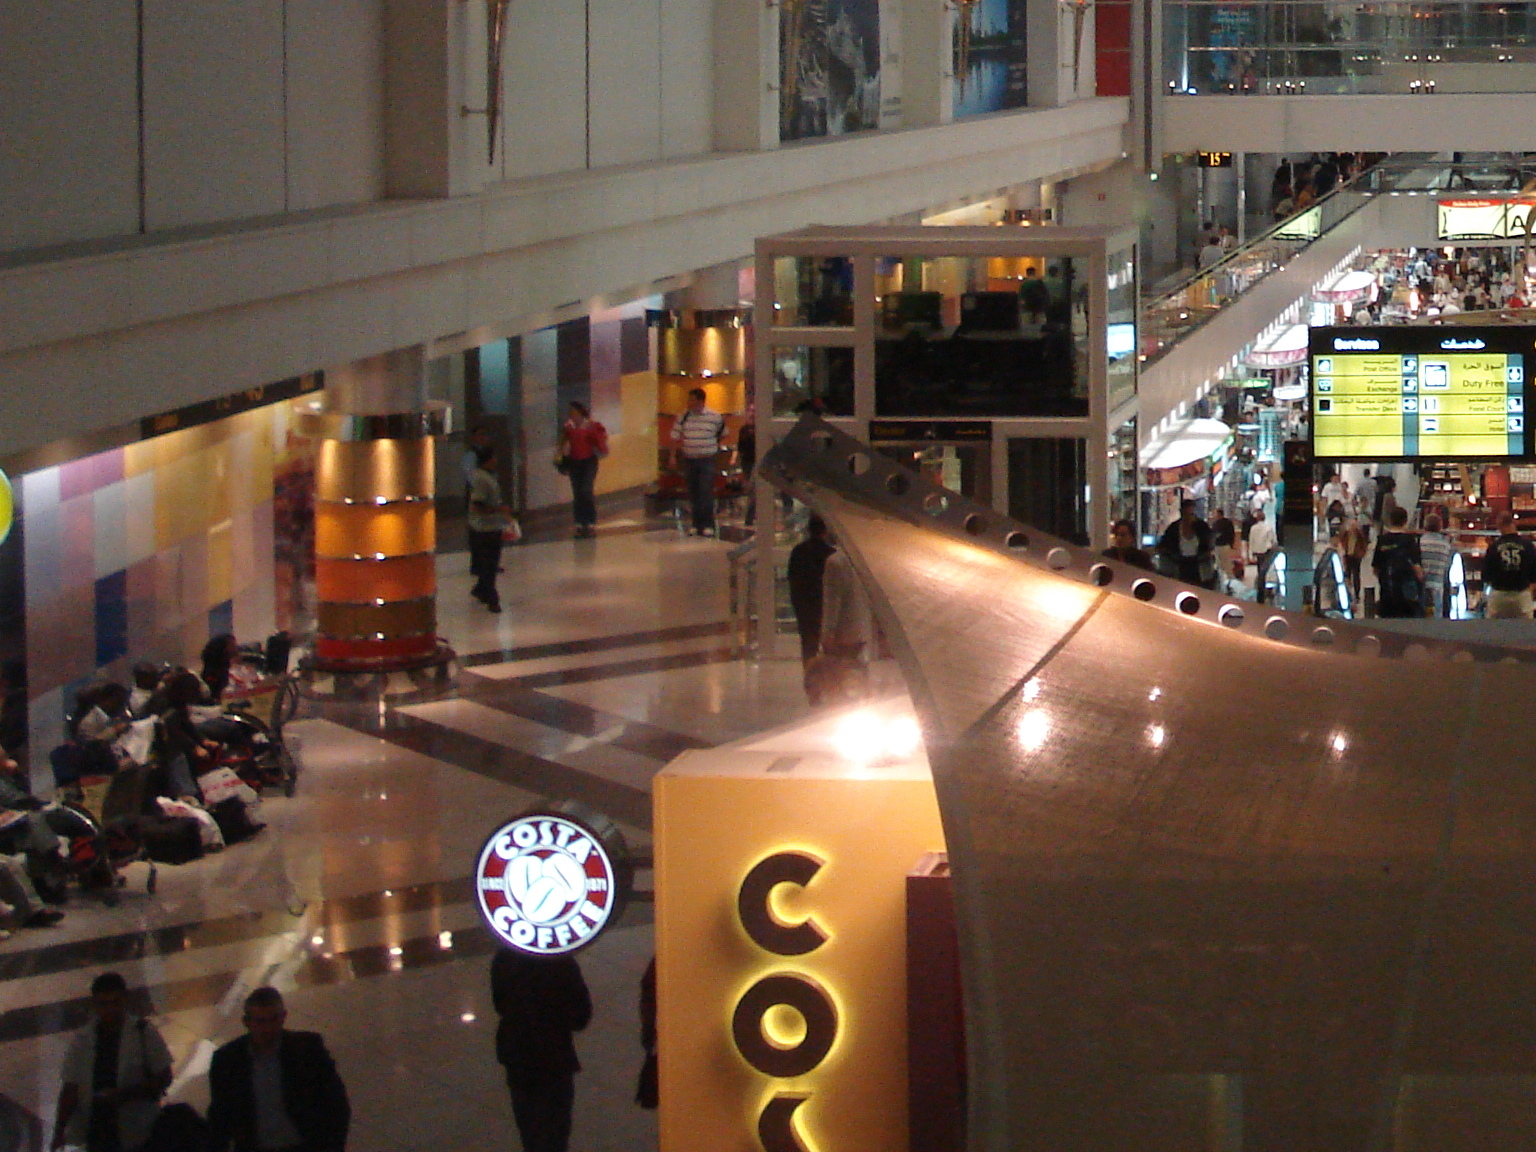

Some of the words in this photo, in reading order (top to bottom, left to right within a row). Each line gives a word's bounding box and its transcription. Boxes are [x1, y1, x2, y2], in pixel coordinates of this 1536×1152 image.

[1462, 379, 1483, 389] Duty
[1485, 379, 1505, 388] Free
[495, 821, 594, 865] COSTA
[494, 900, 605, 949] COFFEE
